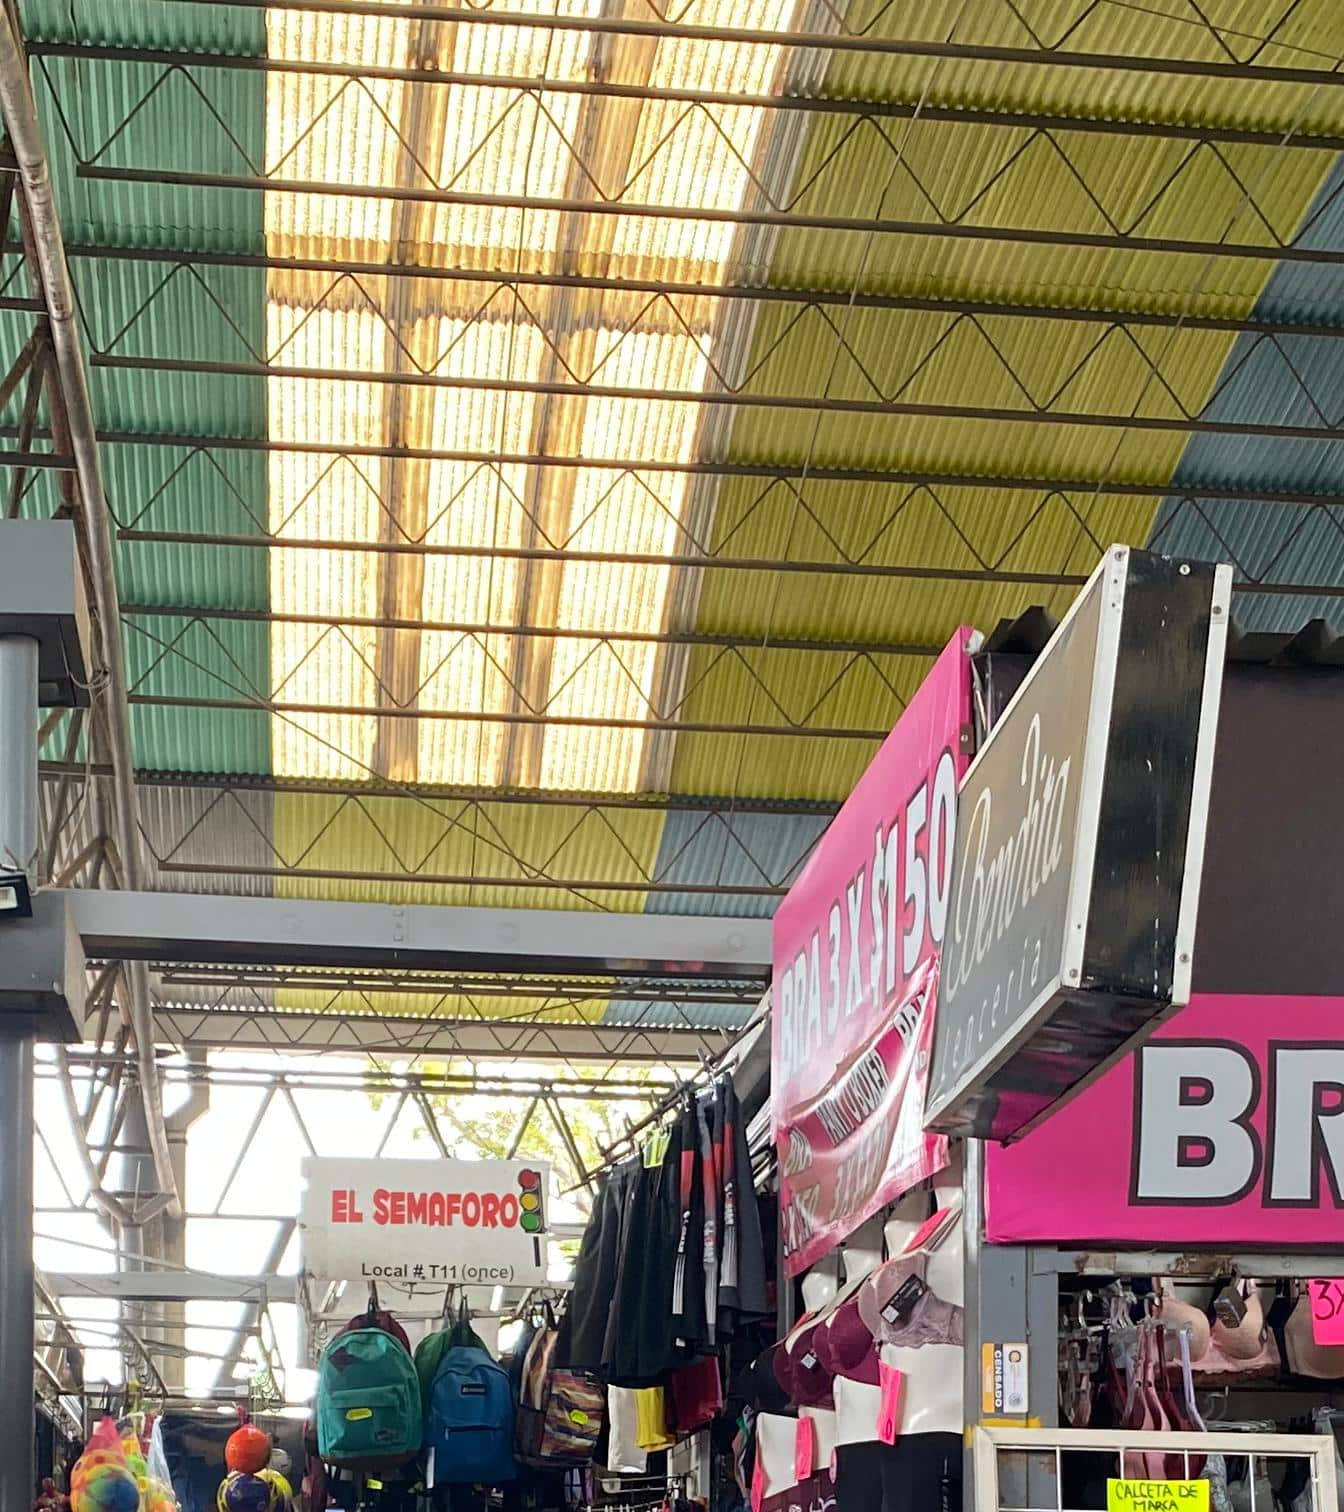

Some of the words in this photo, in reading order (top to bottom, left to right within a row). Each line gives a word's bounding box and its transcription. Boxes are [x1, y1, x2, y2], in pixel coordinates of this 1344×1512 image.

[779, 926, 823, 1089] BRA
[331, 1189, 363, 1223] EL
[372, 1188, 519, 1230] SEMAFORO
[361, 1263, 408, 1277] Local
[429, 1264, 457, 1278] T11
[994, 1350, 1002, 1407] CENSADO
[1115, 1482, 1174, 1499] CALCETA
[1178, 1485, 1198, 1498] DE
[1133, 1500, 1179, 1512] MARCA
